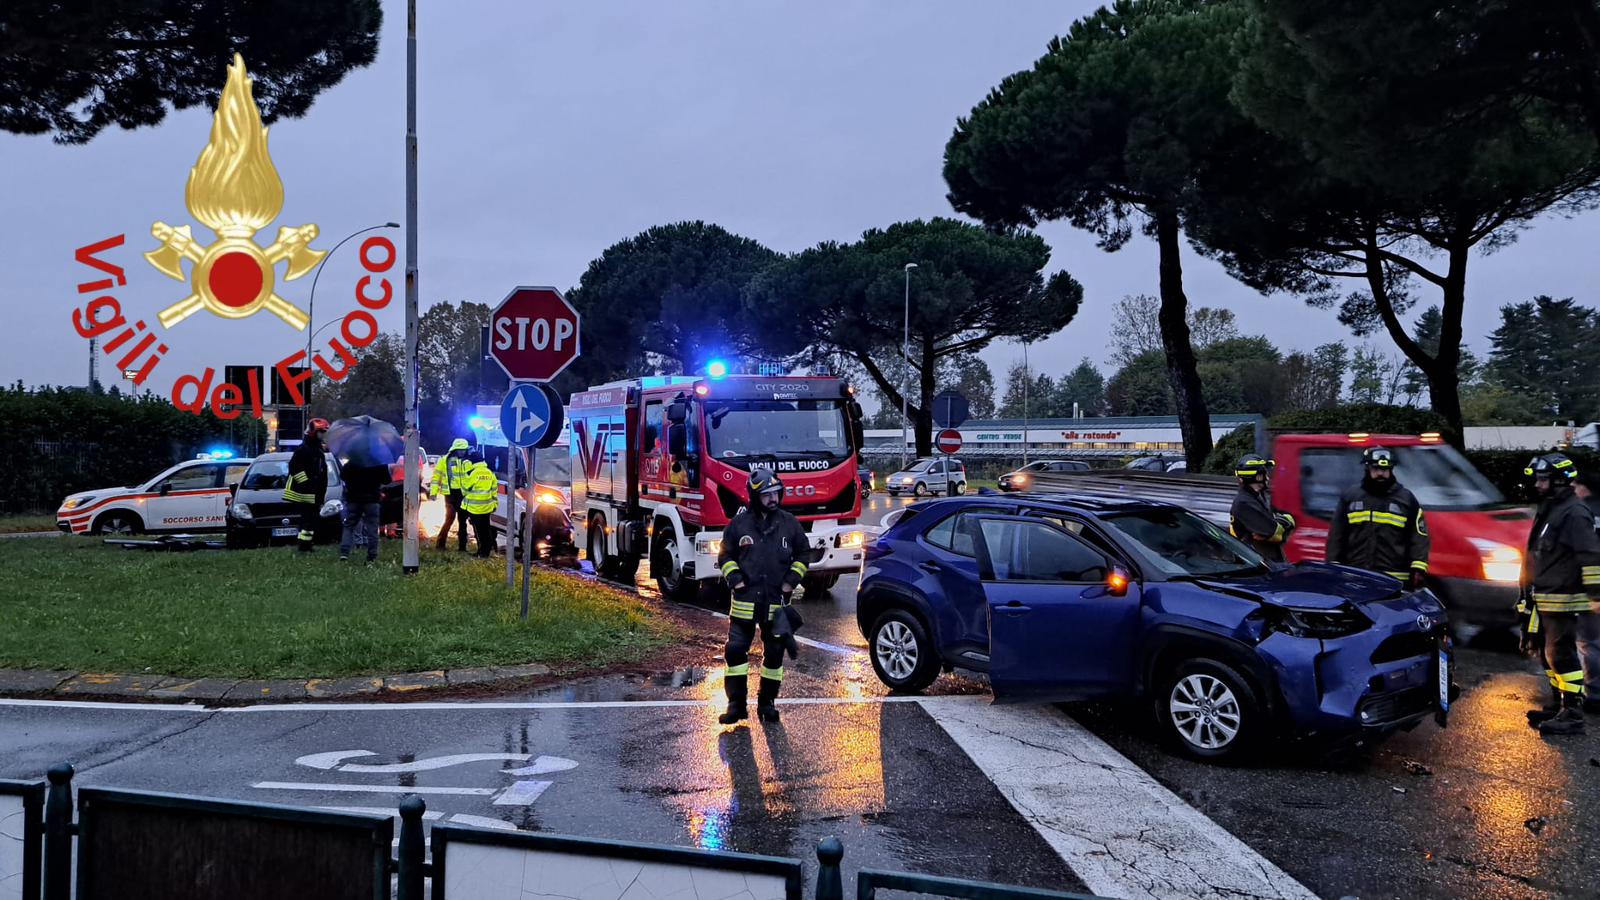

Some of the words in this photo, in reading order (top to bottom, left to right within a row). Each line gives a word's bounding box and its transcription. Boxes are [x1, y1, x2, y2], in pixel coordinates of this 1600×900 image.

[495, 317, 573, 351] STOP
[756, 383, 776, 391] CITY
[780, 383, 809, 391] 2020
[778, 461, 796, 470] DEL
[798, 460, 829, 470] FUOCO
[162, 516, 204, 524] SOCCORSO
